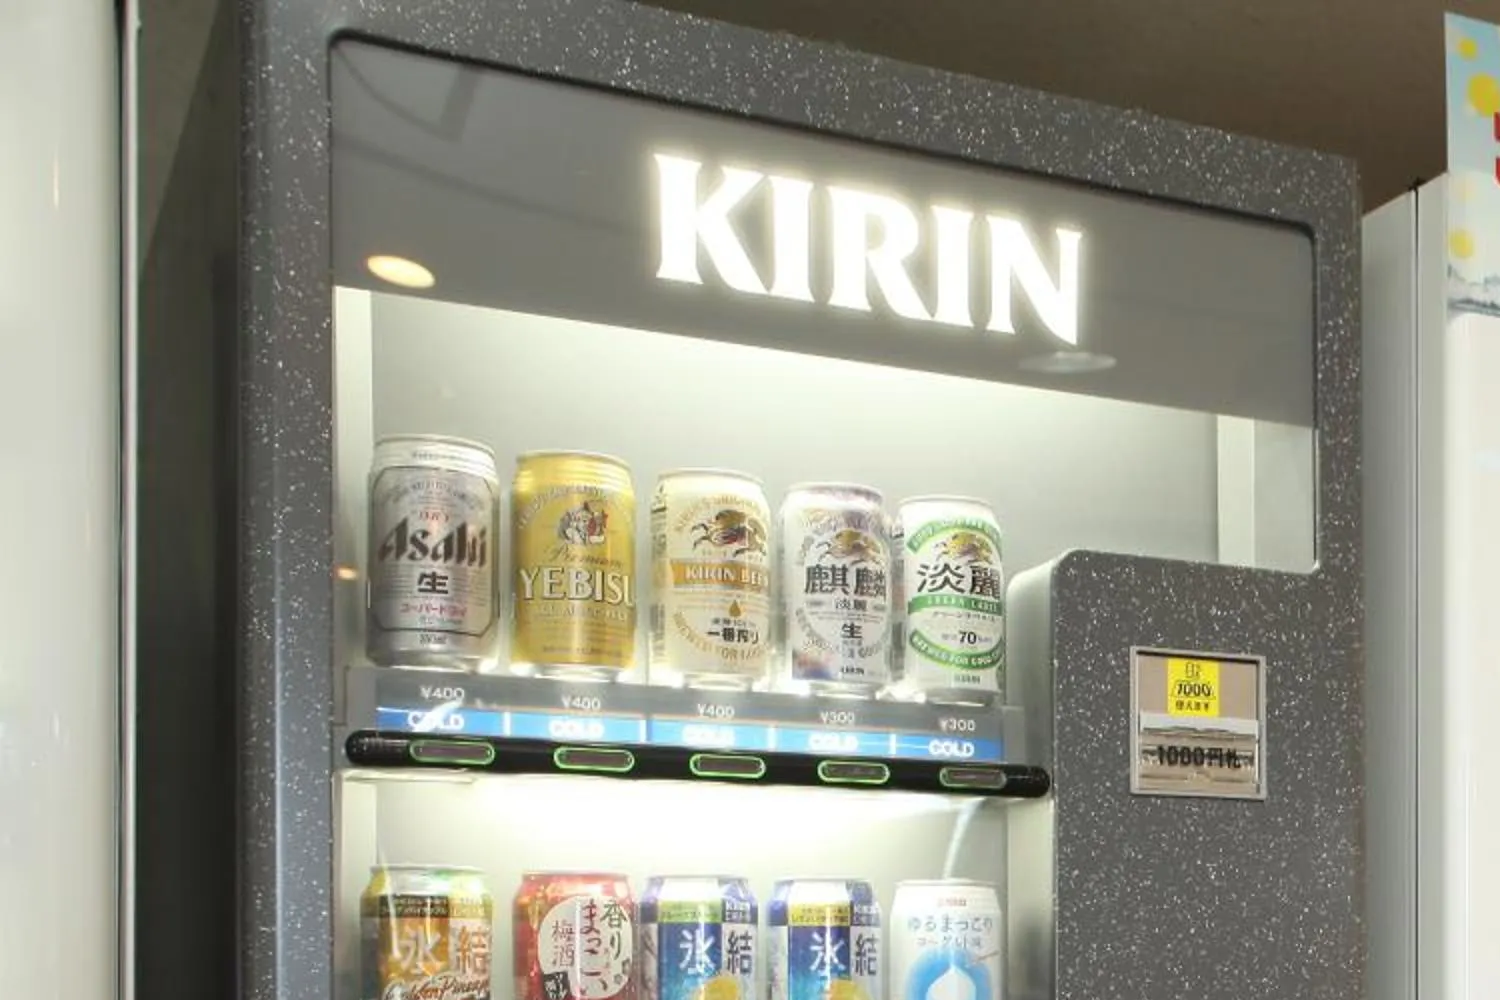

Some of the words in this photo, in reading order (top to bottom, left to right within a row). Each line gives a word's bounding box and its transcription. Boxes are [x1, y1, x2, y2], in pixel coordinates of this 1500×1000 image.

[652, 152, 1084, 346] KIRIN
[378, 516, 488, 567] Asahi
[417, 572, 449, 595] 生
[685, 564, 737, 582] KIRIN
[917, 563, 1001, 600] 淡麗
[841, 622, 863, 640] 生
[958, 630, 977, 645] 70
[407, 711, 465, 732] COLD
[928, 739, 975, 758] COLD
[600, 899, 628, 960] 香り
[679, 928, 753, 976] 氷結
[810, 931, 878, 977] 氷結
